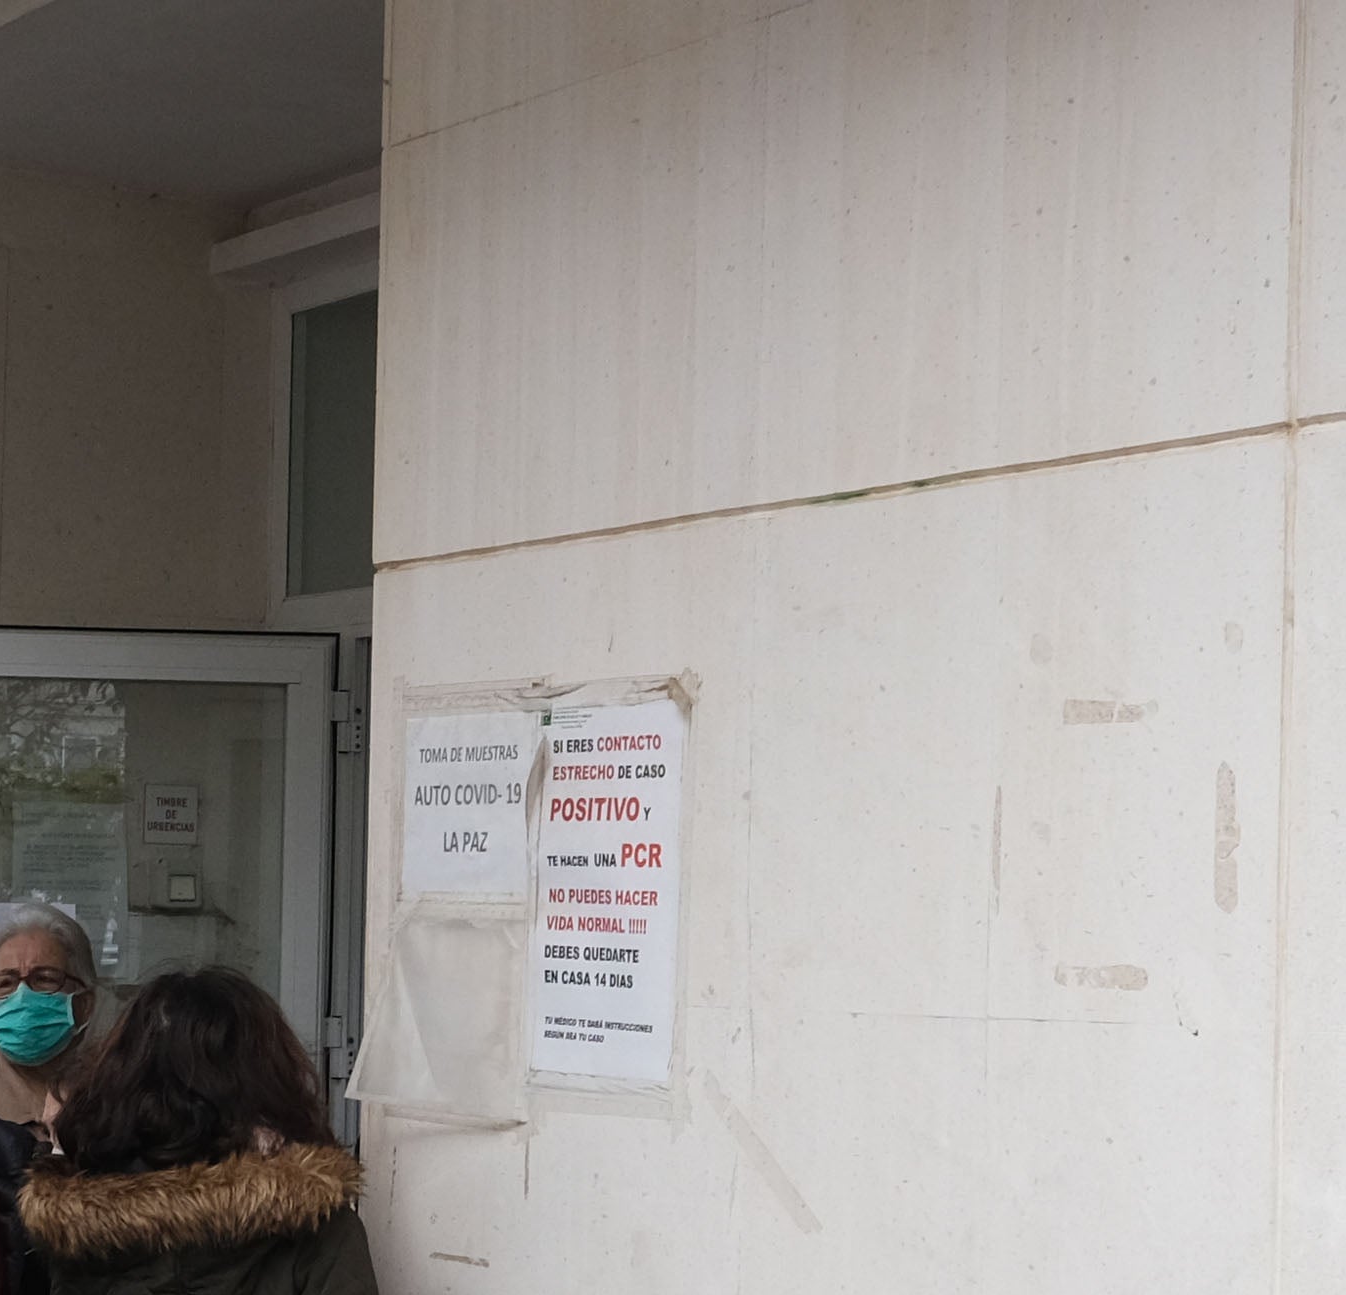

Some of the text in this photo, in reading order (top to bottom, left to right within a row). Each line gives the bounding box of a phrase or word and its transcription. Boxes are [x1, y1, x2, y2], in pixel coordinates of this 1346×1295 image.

[553, 734, 662, 753] SI ERES CONTACTO
[419, 744, 519, 763] TOMA DE MUESTRAS
[552, 763, 666, 781] ESTRECHO DE CASO
[156, 797, 188, 808] TIMBRE
[414, 782, 522, 806] AUTO COVID- 19
[165, 810, 178, 820] DE
[550, 796, 651, 822] POSITIVO Y
[147, 821, 195, 832] URGENCIAS
[443, 831, 489, 853] LA PAZ
[547, 842, 662, 868] TE HACEN UNA PCR
[549, 888, 658, 906] NO PUEDES HACER
[547, 915, 574, 931] VIDA
[577, 916, 625, 933] NORMAL
[544, 944, 640, 963] DEBES QUEDARTE
[544, 969, 634, 989] EN CASA 14 DIAS
